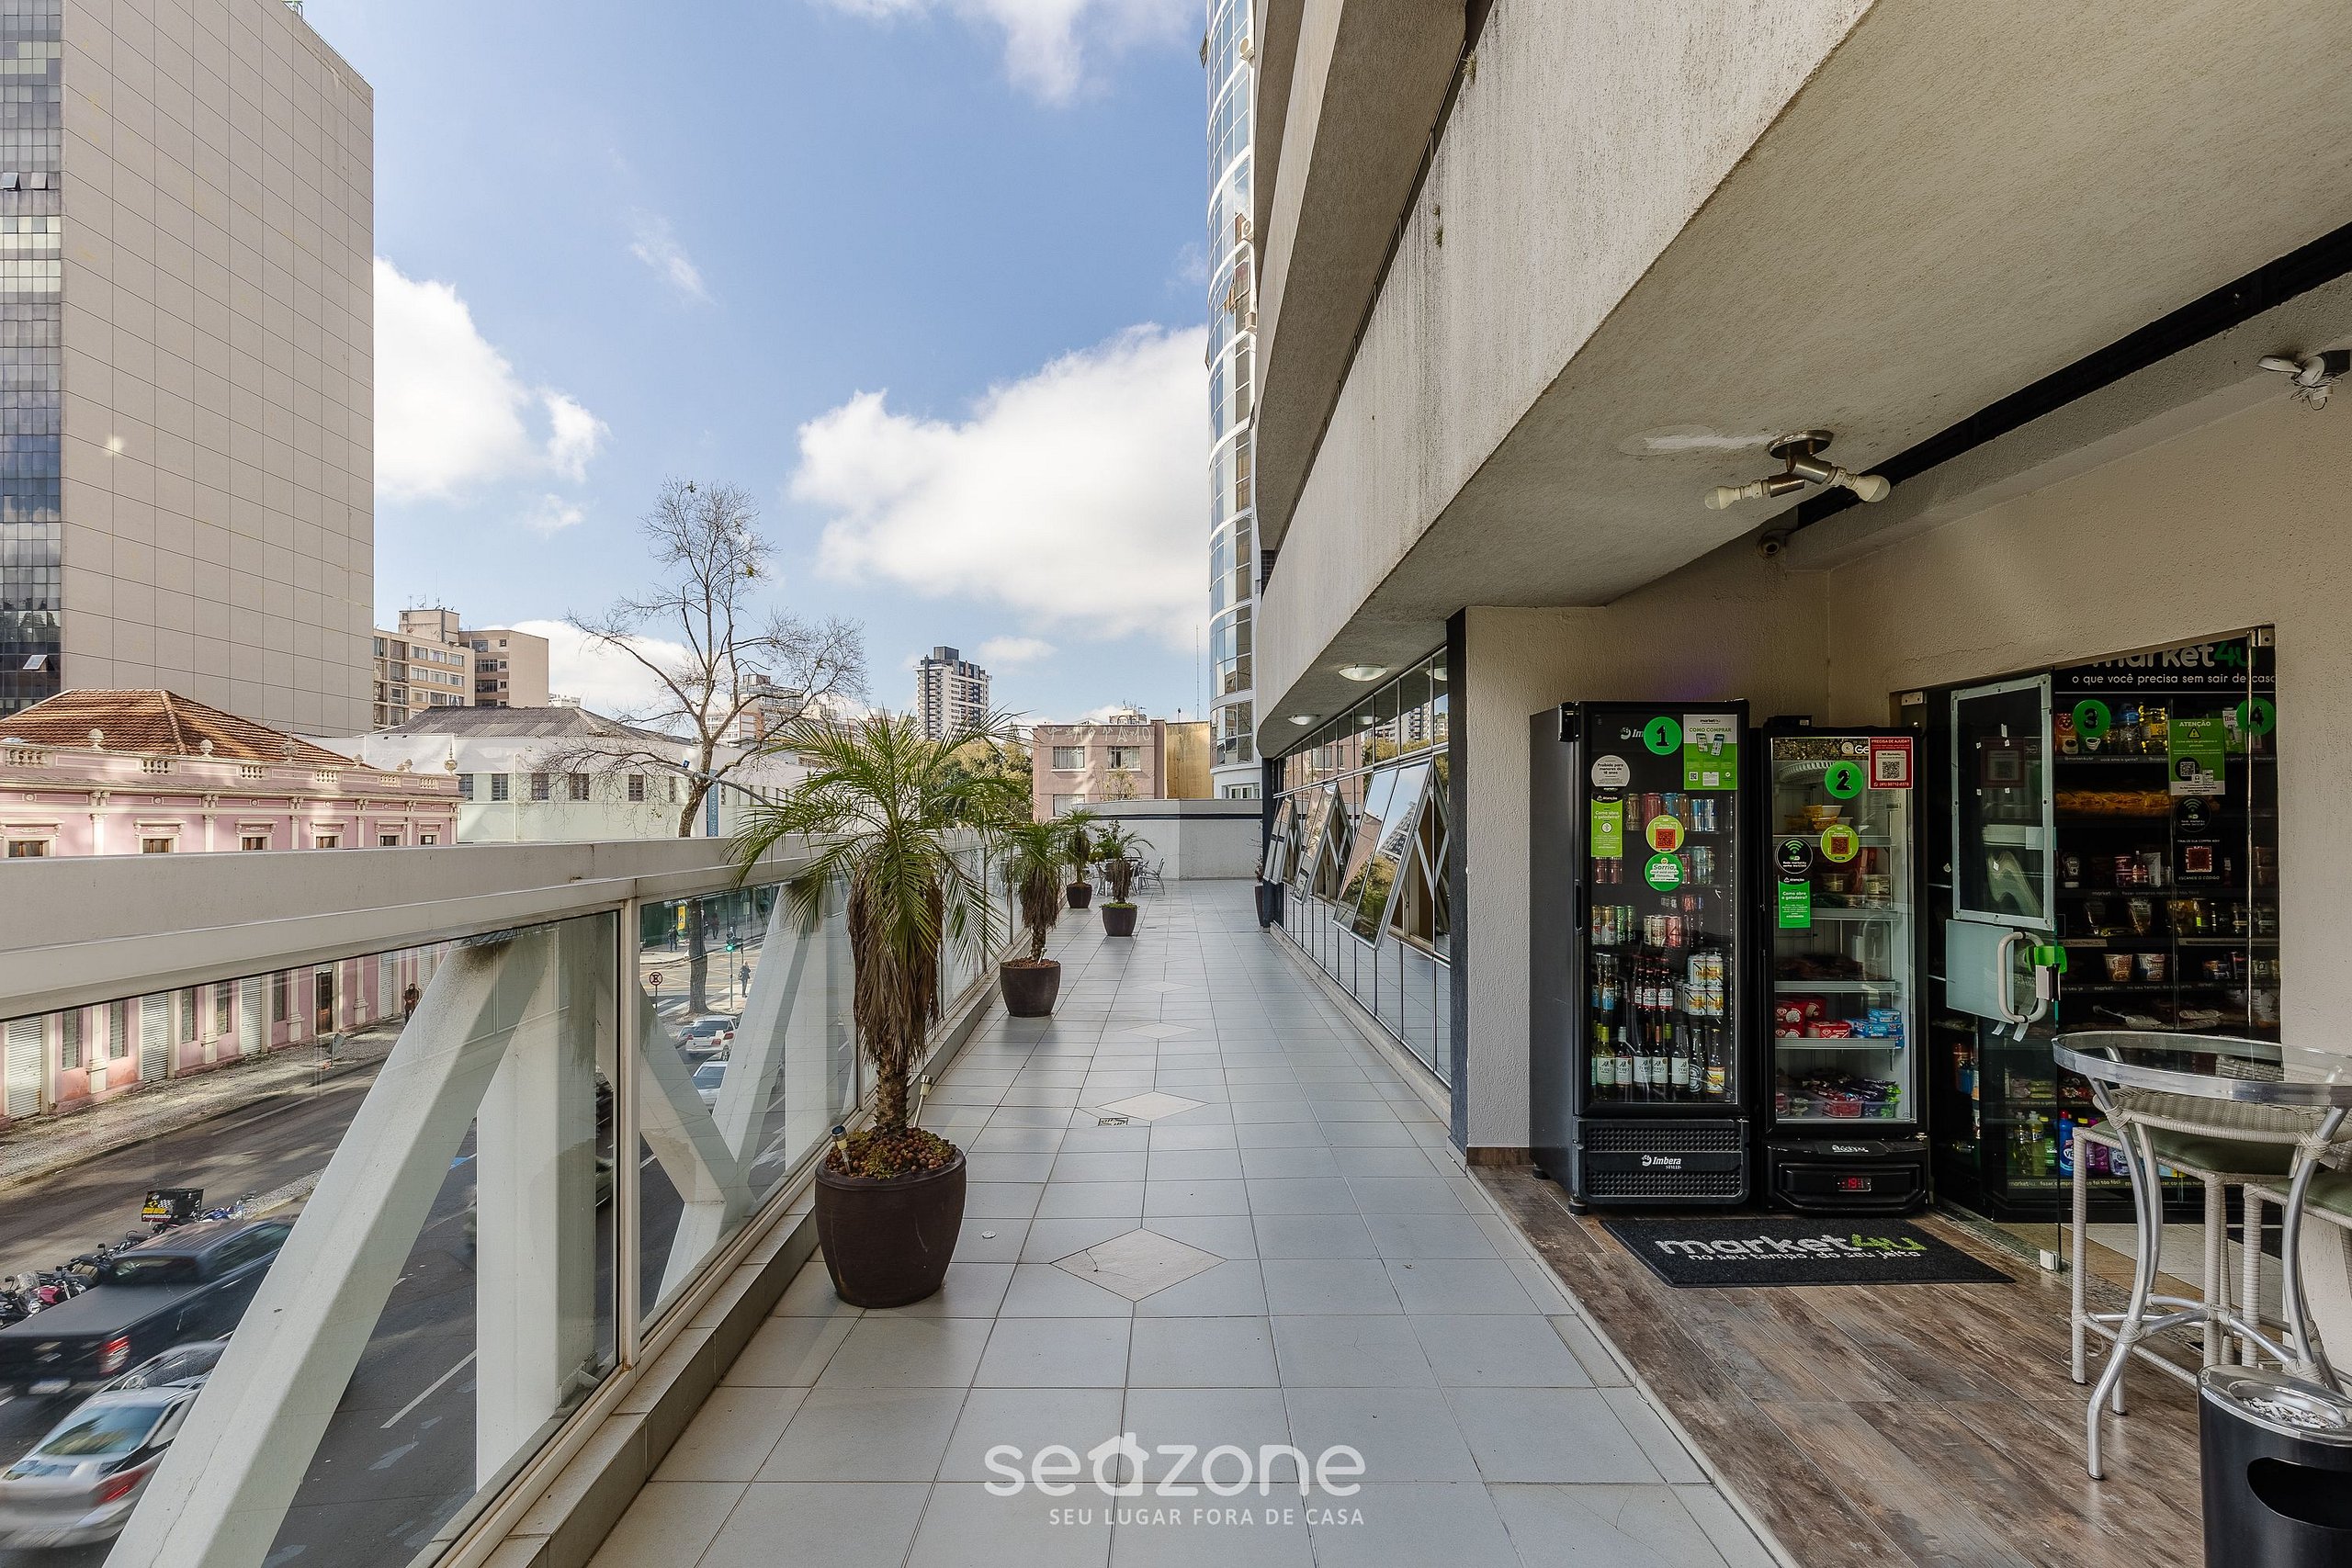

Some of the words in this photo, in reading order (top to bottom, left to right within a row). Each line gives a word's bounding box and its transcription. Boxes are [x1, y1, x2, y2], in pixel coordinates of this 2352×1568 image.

[2083, 676, 2104, 686] que
[2108, 673, 2133, 683] você
[2137, 673, 2178, 686] precisa
[2182, 675, 2203, 683] sem
[2208, 673, 2229, 683] sair
[2232, 672, 2247, 683] de
[2084, 707, 2098, 729] 3
[2178, 720, 2211, 728] ATENÇÃO
[1656, 725, 1669, 747] 1
[1836, 769, 1852, 790] 2
[1652, 1156, 1682, 1165] Imbera
[1654, 1234, 1928, 1255] market4u
